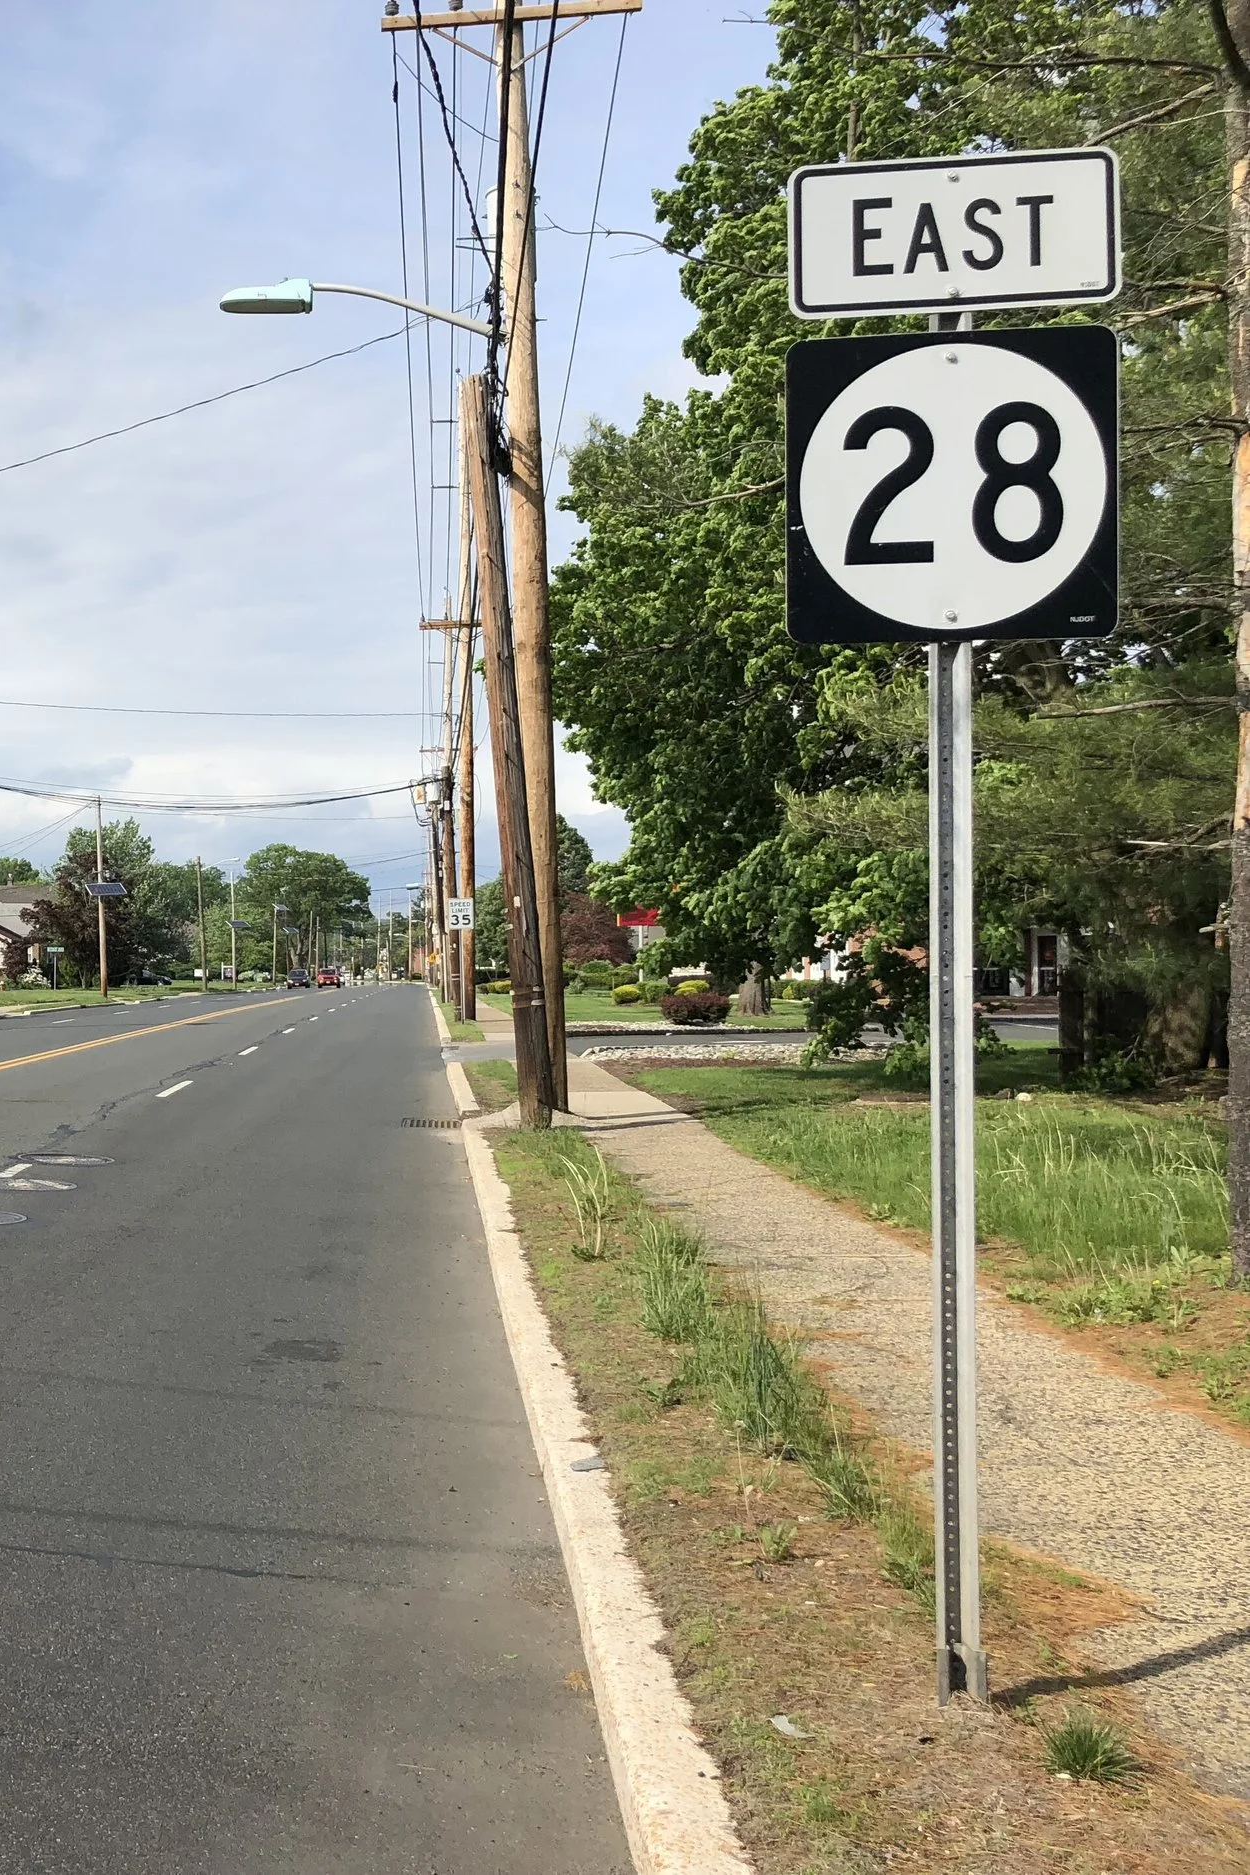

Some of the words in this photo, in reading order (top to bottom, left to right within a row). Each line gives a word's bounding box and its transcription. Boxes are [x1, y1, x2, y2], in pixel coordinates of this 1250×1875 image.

[852, 194, 1054, 277] EAST
[843, 401, 1064, 566] 28
[451, 914, 471, 925] 35
